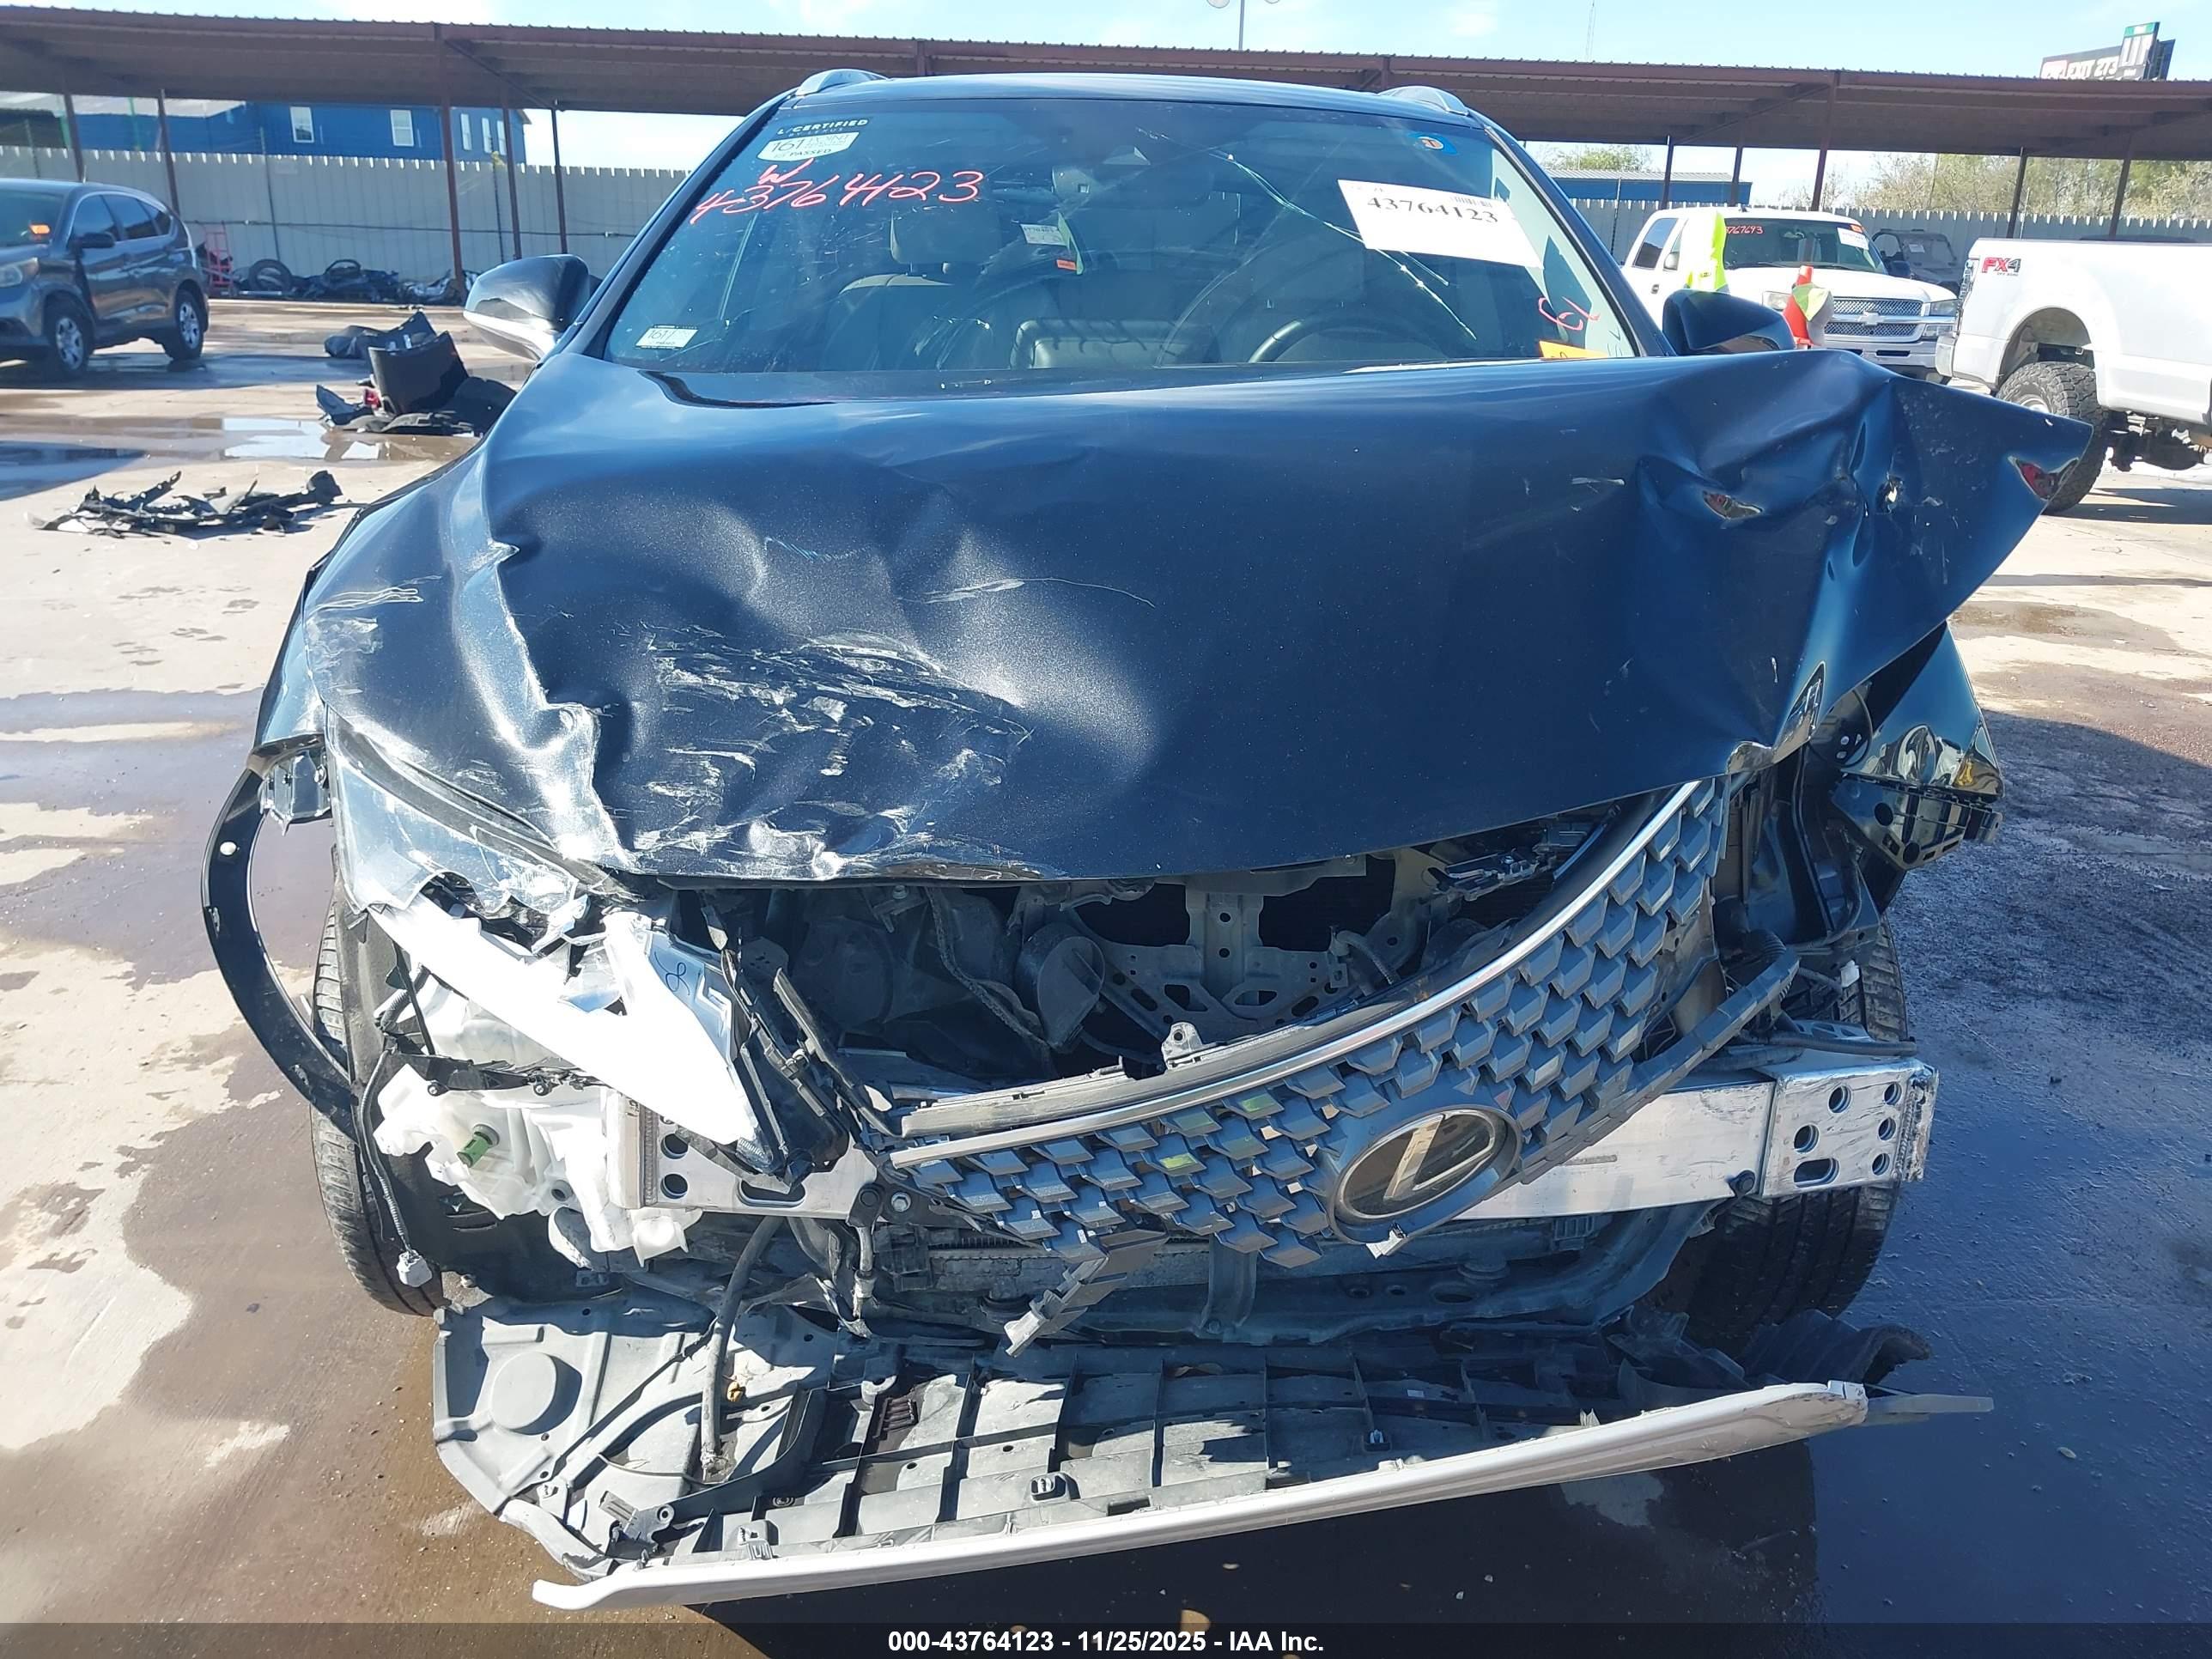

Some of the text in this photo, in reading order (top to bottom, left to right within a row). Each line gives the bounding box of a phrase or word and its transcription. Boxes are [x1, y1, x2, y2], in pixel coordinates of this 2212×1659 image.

[772, 139, 805, 153] 161
[1367, 196, 1499, 223] 43764123
[1981, 257, 2021, 273] FX4
